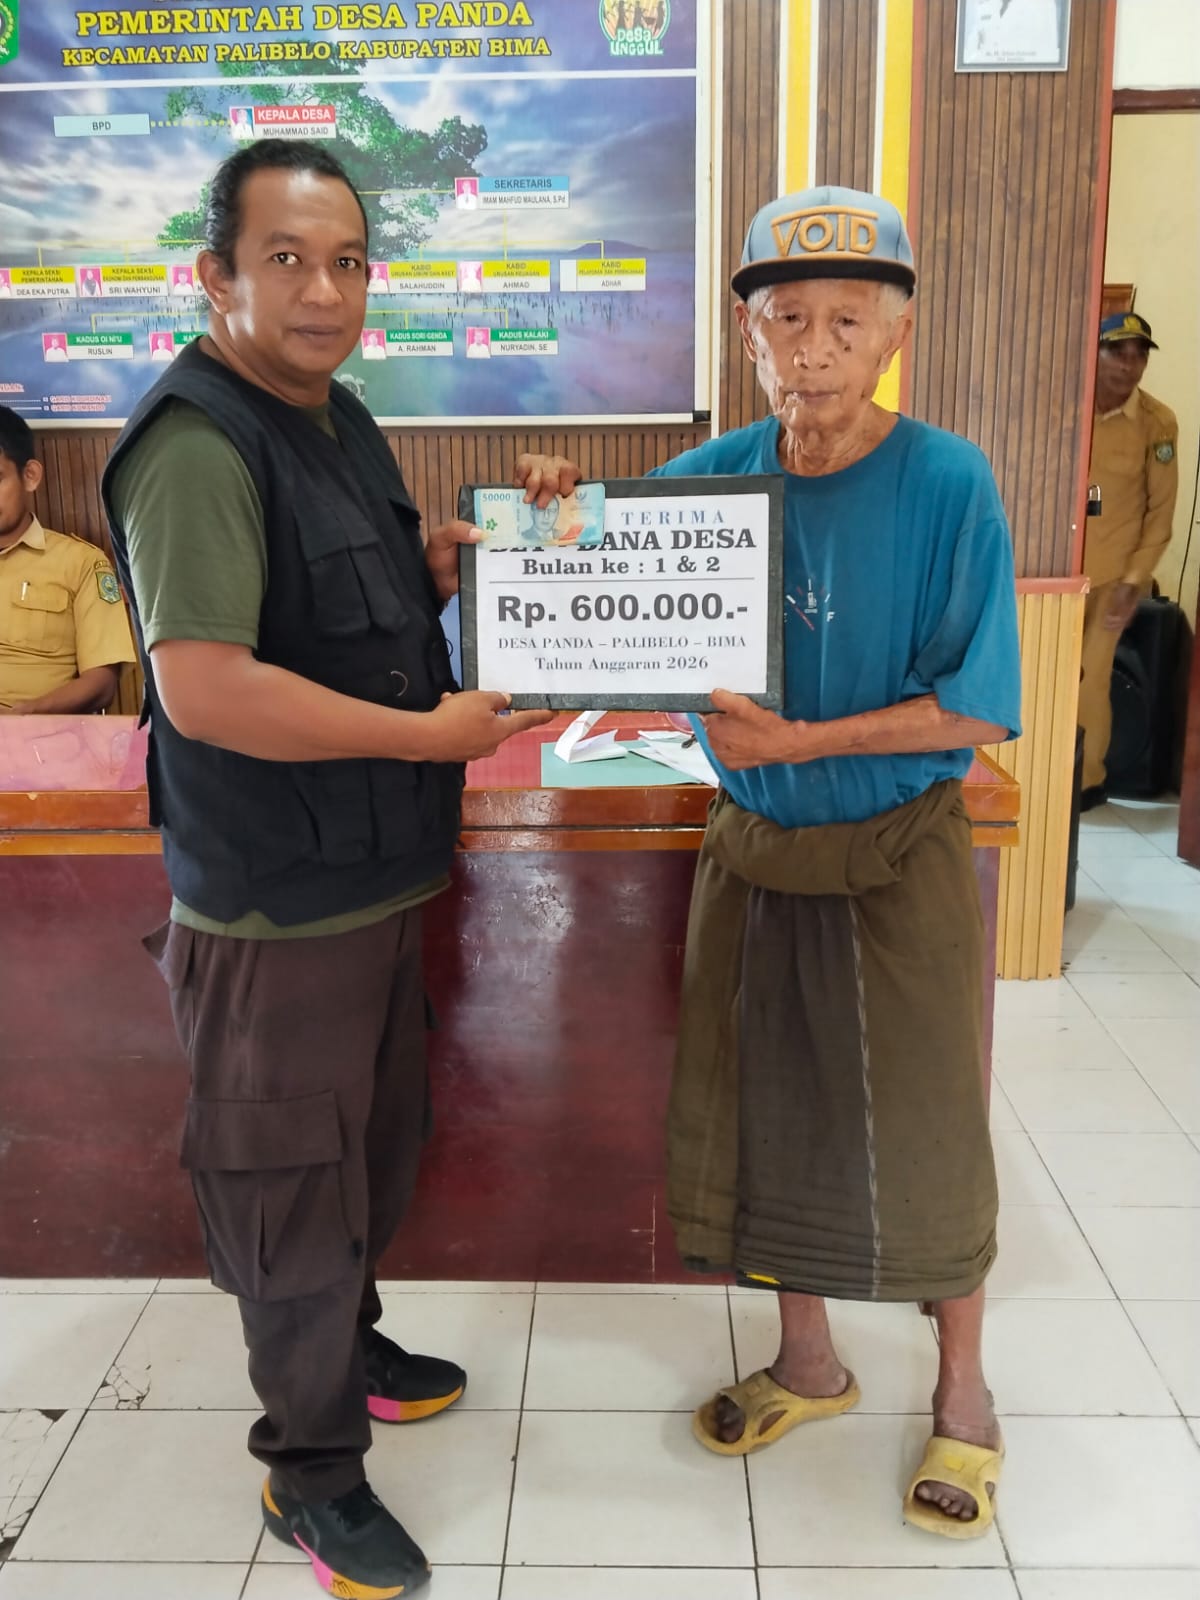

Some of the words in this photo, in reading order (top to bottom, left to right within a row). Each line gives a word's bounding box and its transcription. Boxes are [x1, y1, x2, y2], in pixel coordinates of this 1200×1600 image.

[76, 6, 302, 36] PEMERINTAH
[313, 4, 407, 30] DESA
[416, 1, 533, 28] PANDA
[62, 45, 208, 66] KECAMATAN
[215, 42, 332, 62] PALIBELO
[338, 39, 481, 59] KABUPATEN
[488, 38, 551, 56] BIMA
[610, 40, 664, 56] UNGGUL
[258, 109, 300, 121] KEPALA
[302, 109, 331, 120] DESA
[92, 121, 111, 131] BPD
[263, 128, 308, 136] MUHAMMAD
[311, 127, 328, 135] SAID
[494, 179, 552, 189] SEKRETARIS
[771, 205, 878, 259] VOID
[123, 286, 161, 294] WAHYUNI
[399, 282, 445, 290] SALAHUDDIN
[503, 281, 530, 289] AHMAD
[47, 287, 70, 295] PUTRA
[75, 335, 100, 343] KADUS
[389, 332, 411, 340] KADUS
[499, 331, 522, 339] KADUS
[406, 344, 436, 352] RAHMAN
[500, 343, 537, 352] NURYADIN,
[538, 343, 548, 351] SE
[482, 493, 511, 502] 50000
[621, 510, 724, 526] TERIMA
[577, 530, 662, 551] ANA
[671, 528, 757, 550] DESA
[522, 559, 593, 575] Bulan
[601, 558, 630, 574] ke
[656, 558, 666, 573] 1
[677, 555, 697, 573] &
[706, 556, 721, 572] 2
[498, 596, 557, 628] Rp.
[570, 593, 748, 621] 600.000.-
[826, 611, 836, 623] F
[498, 638, 537, 649] DESA
[542, 638, 594, 648] PANDA
[612, 636, 689, 648] PALIBELO
[707, 636, 746, 647] BIMA
[535, 657, 582, 670] Tahun
[588, 657, 660, 673] Anggaran
[666, 656, 709, 669] 2026
